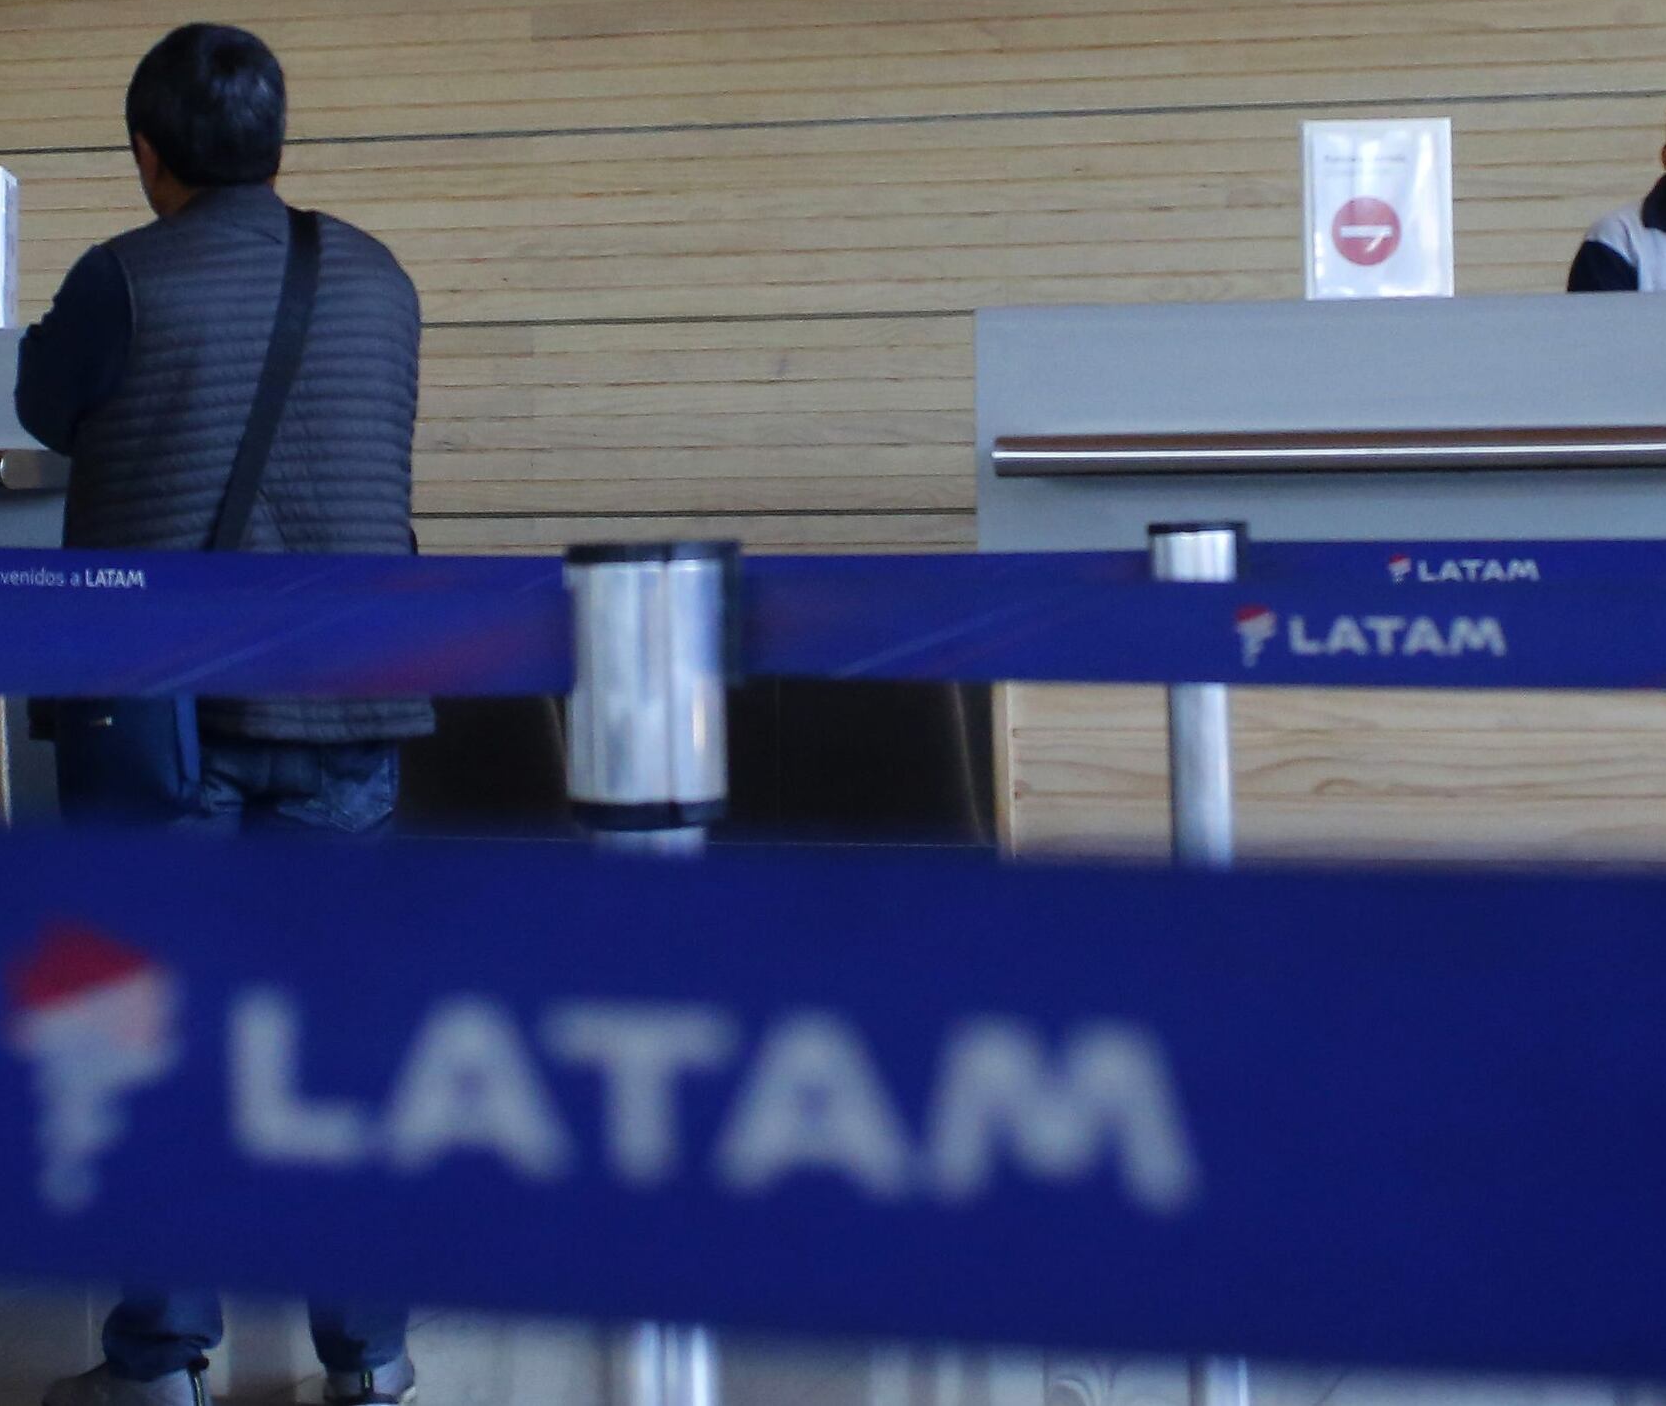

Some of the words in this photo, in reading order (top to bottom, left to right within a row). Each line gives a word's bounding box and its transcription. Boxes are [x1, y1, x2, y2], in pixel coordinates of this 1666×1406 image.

[70, 571, 81, 587] a
[85, 569, 147, 587] LATAM
[1415, 558, 1540, 582] LATAM
[1288, 614, 1508, 659] LATAM
[228, 986, 1201, 1212] LATAM
